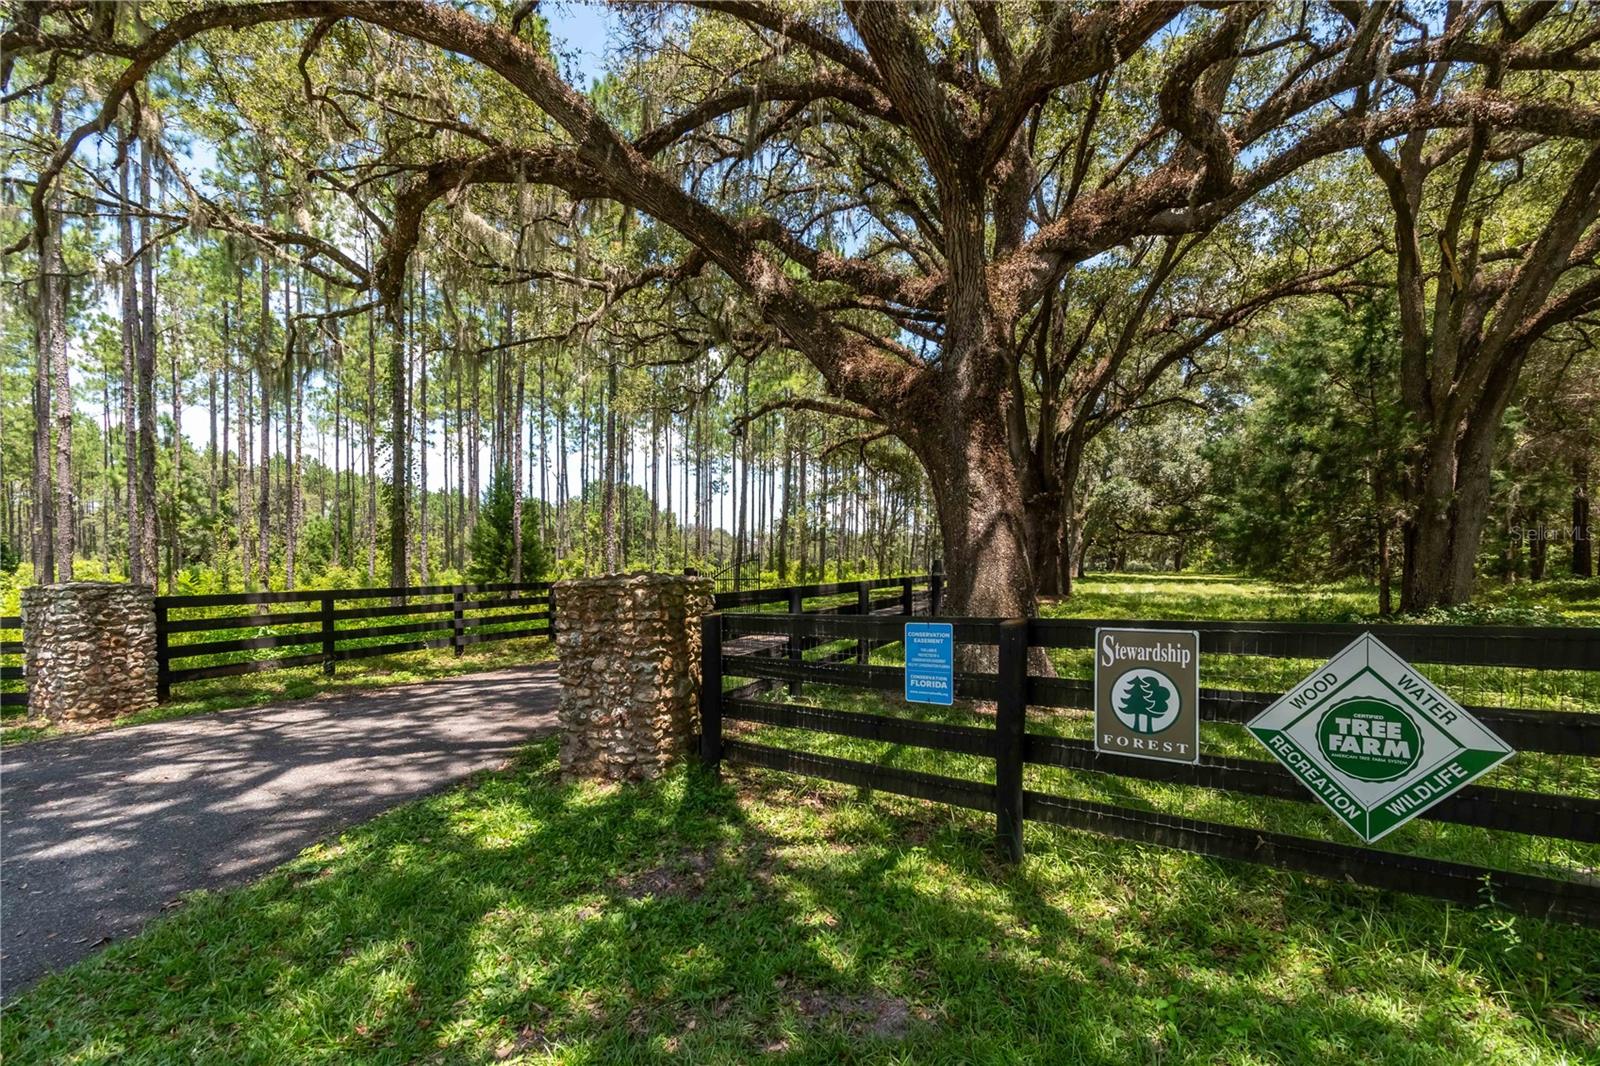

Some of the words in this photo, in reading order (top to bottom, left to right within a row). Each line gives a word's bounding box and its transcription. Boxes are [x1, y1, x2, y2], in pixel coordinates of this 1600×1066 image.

[1101, 634, 1191, 669] Stewardship
[910, 680, 948, 689] FLORIDA
[1289, 672, 1339, 711] WOOD
[1396, 674, 1458, 726] WATER
[1103, 734, 1189, 754] FOREST
[1335, 717, 1402, 739] TREE
[1328, 733, 1411, 759] FARM
[1268, 734, 1361, 820] RECREATION
[1385, 762, 1469, 818] WILDLIFE
